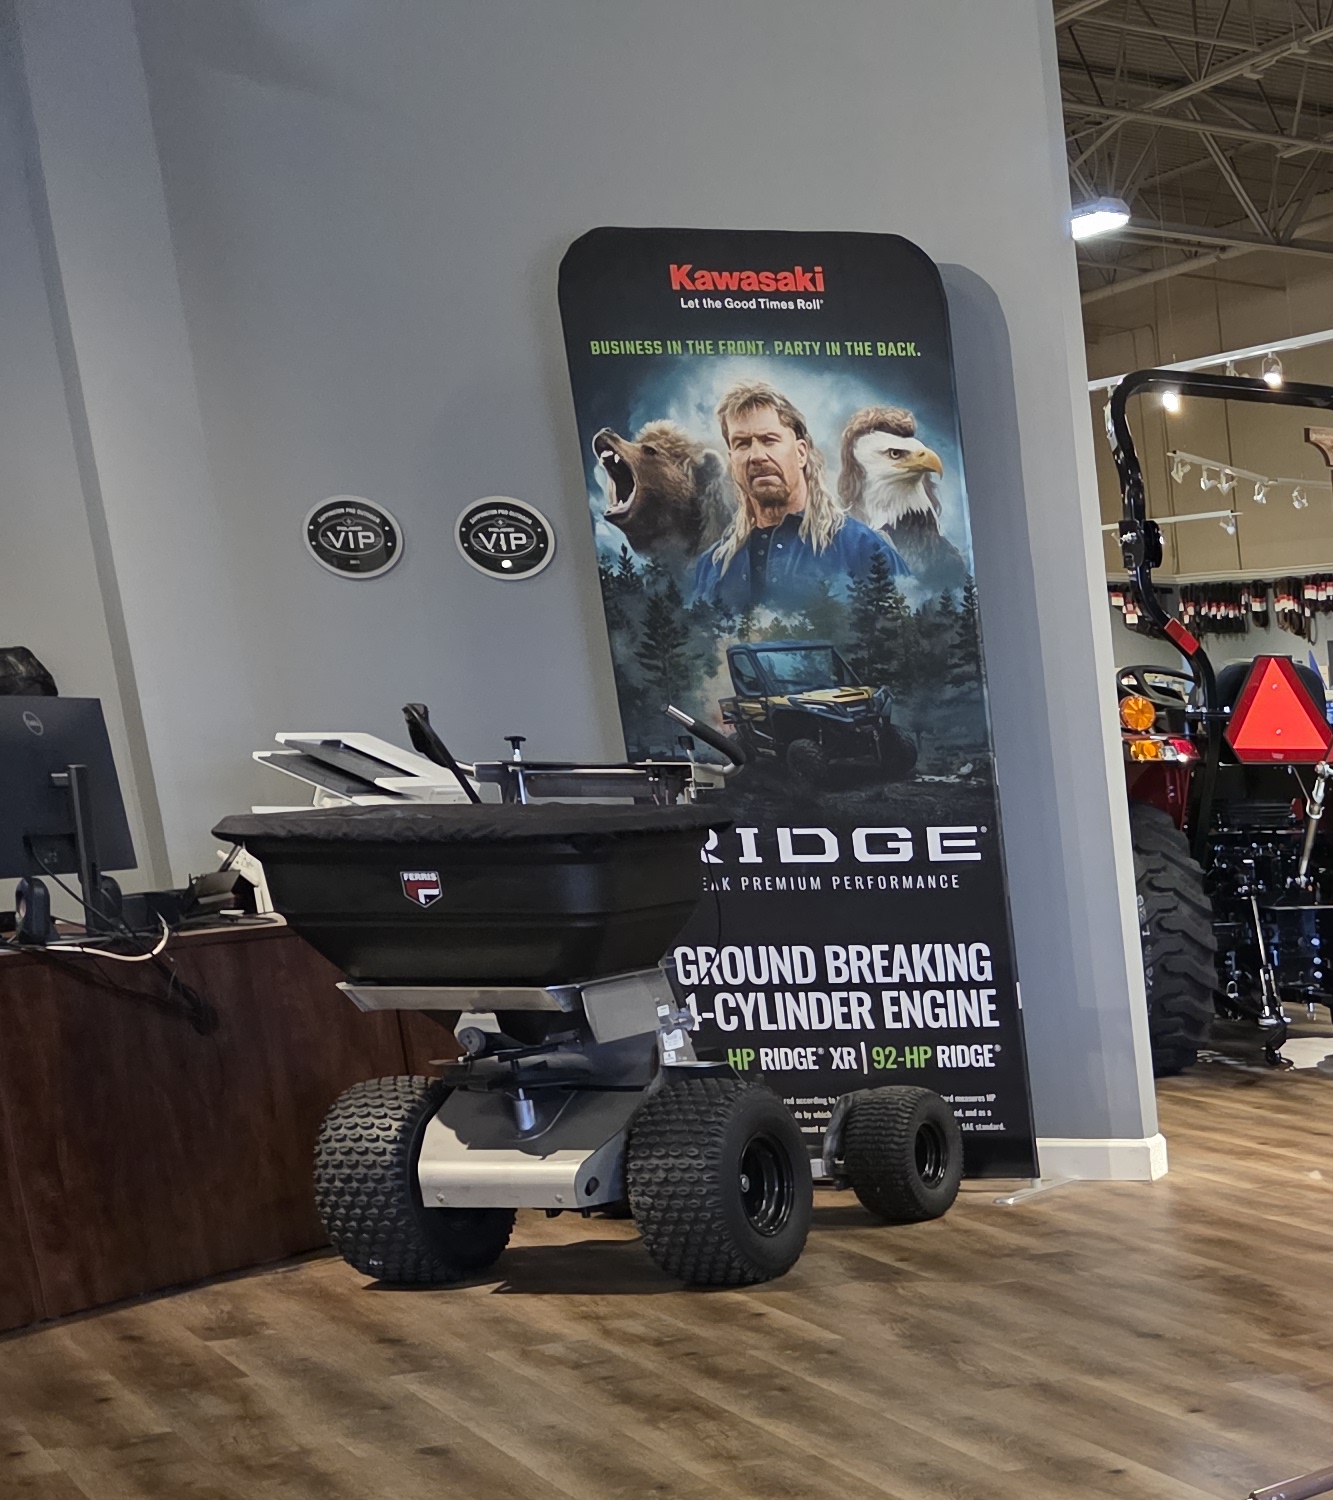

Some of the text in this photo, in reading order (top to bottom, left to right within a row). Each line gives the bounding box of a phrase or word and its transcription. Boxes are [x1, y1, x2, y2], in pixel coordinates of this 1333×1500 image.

[669, 264, 825, 292] Kawasaki
[680, 297, 700, 309] Let
[703, 298, 722, 309] the
[724, 298, 757, 309] Good
[758, 298, 794, 310] Times
[590, 340, 921, 357] BUSINESS IN THE FRONT. PARTY IN THE BACK.
[326, 531, 375, 549] VIP
[478, 532, 527, 551] VIP
[403, 872, 438, 881] FERRIS
[741, 874, 960, 891] PREMIUM PERFORMANCE
[673, 942, 993, 986] GROUND BREAKING
[685, 988, 1000, 1031] 4-CYLINDER ENGINE
[829, 1047, 857, 1069] XR
[873, 1046, 932, 1069] 92-HP
